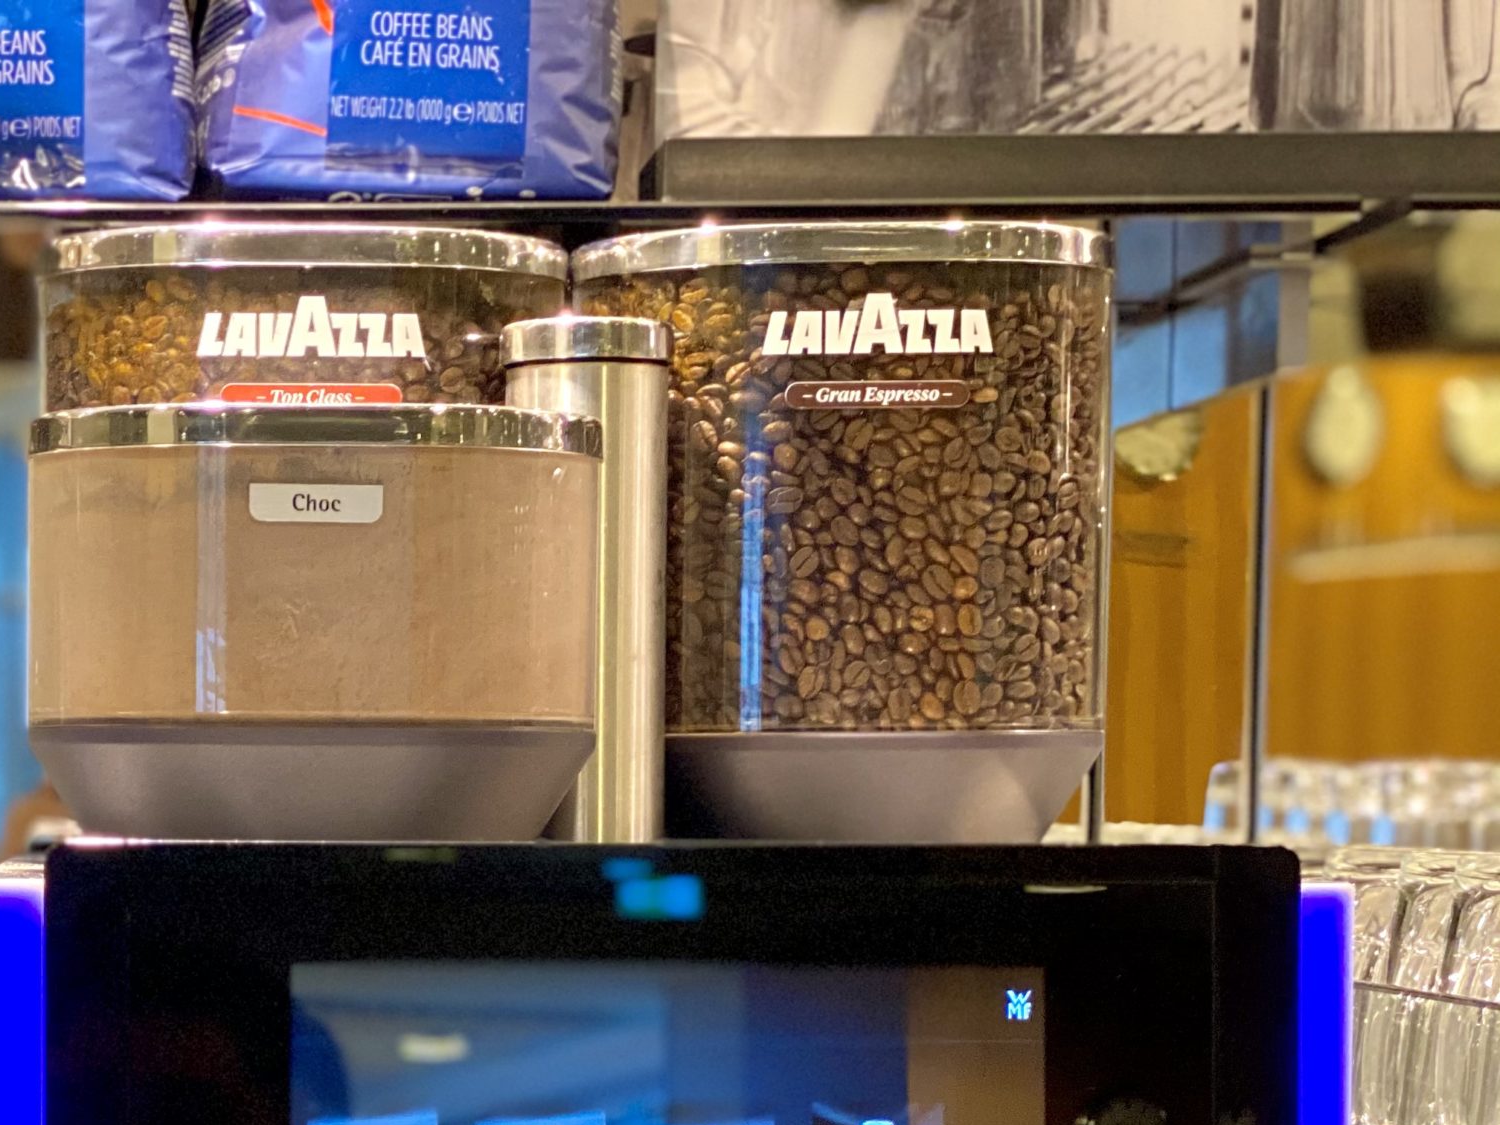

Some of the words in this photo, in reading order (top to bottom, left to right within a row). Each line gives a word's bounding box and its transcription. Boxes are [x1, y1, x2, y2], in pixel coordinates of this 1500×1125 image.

[371, 11, 431, 38] COFFEE
[436, 14, 493, 41] BEANS
[361, 36, 404, 66] CAFÉ
[408, 42, 431, 67] EN
[436, 43, 500, 72] GRAINS
[331, 95, 349, 117] NET
[350, 96, 387, 118] WEIGHT
[477, 101, 505, 123] POIDS
[506, 102, 525, 124] NET
[33, 117, 62, 138] POIDS
[62, 117, 82, 138] NET
[196, 295, 426, 358] LAVAZZA
[762, 292, 994, 355] LAVAZZA
[306, 388, 352, 404] Class
[815, 387, 861, 403] Gran
[863, 386, 940, 405] Espresso
[291, 493, 342, 512] Choc
